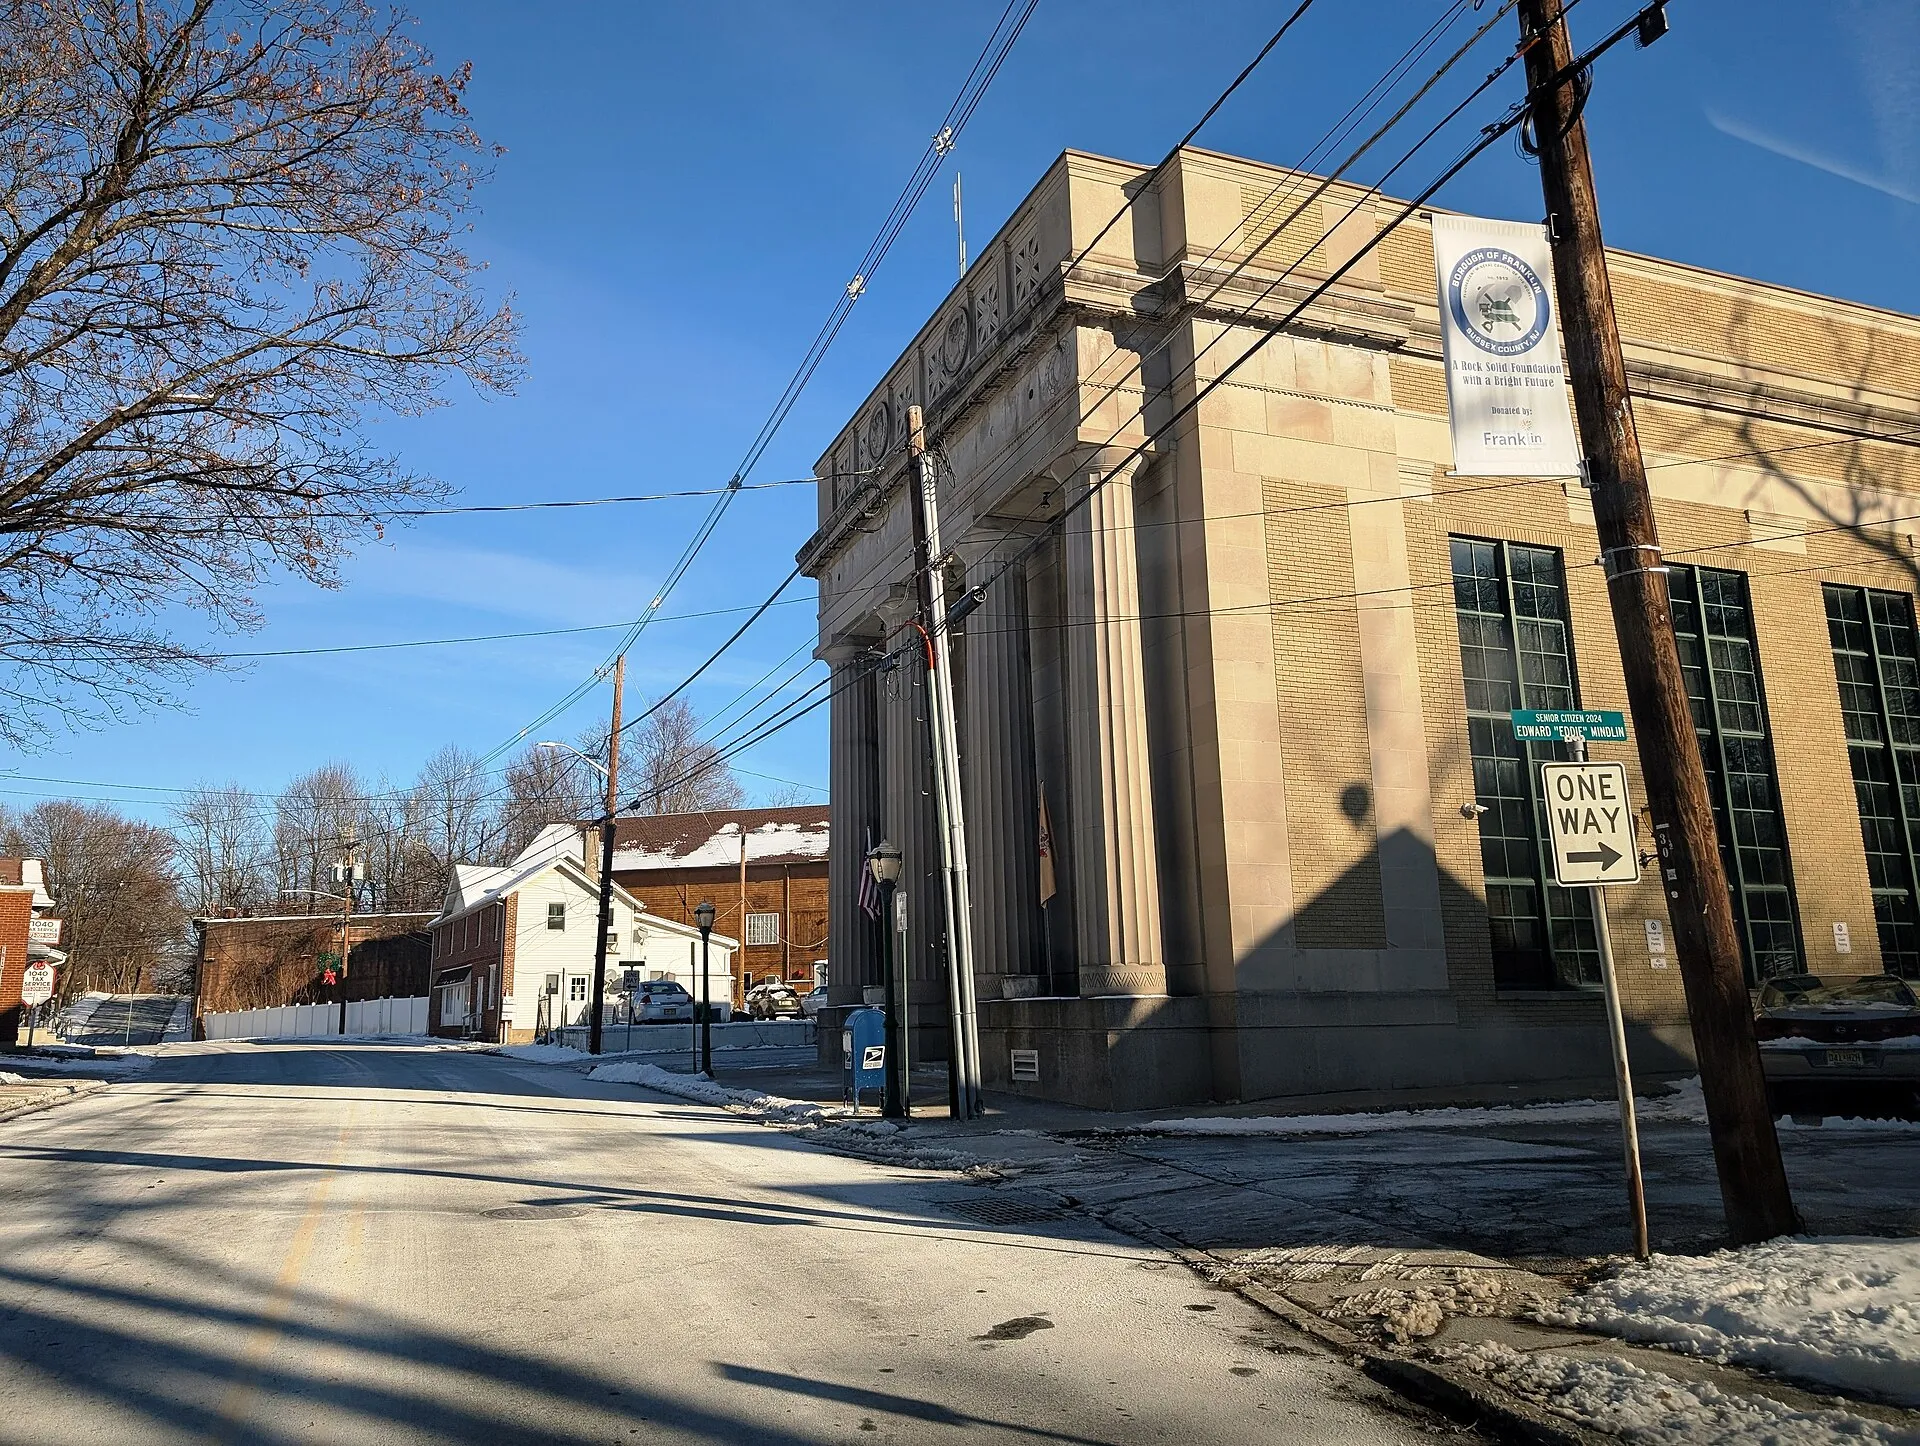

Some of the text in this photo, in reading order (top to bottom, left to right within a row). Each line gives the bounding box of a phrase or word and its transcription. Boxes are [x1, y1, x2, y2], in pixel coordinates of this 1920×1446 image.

[1452, 252, 1484, 287] BOROUGH
[1487, 251, 1499, 259] OF
[1502, 254, 1542, 295] FRANKLIN
[1466, 327, 1540, 353] SUSSEX COUNTY, NJ
[1452, 360, 1562, 374] A Rock Solid Foundation
[1485, 376, 1491, 385] a
[1494, 375, 1522, 387] Bright
[1525, 377, 1555, 387] Future
[1491, 406, 1533, 416] Donated by:
[1535, 713, 1602, 723] SENIOR CITIZEN 2024
[1516, 725, 1625, 737] EDWARD "EDDIE" MINDLIN
[1556, 773, 1616, 801] ONE
[1557, 806, 1620, 834] WAY
